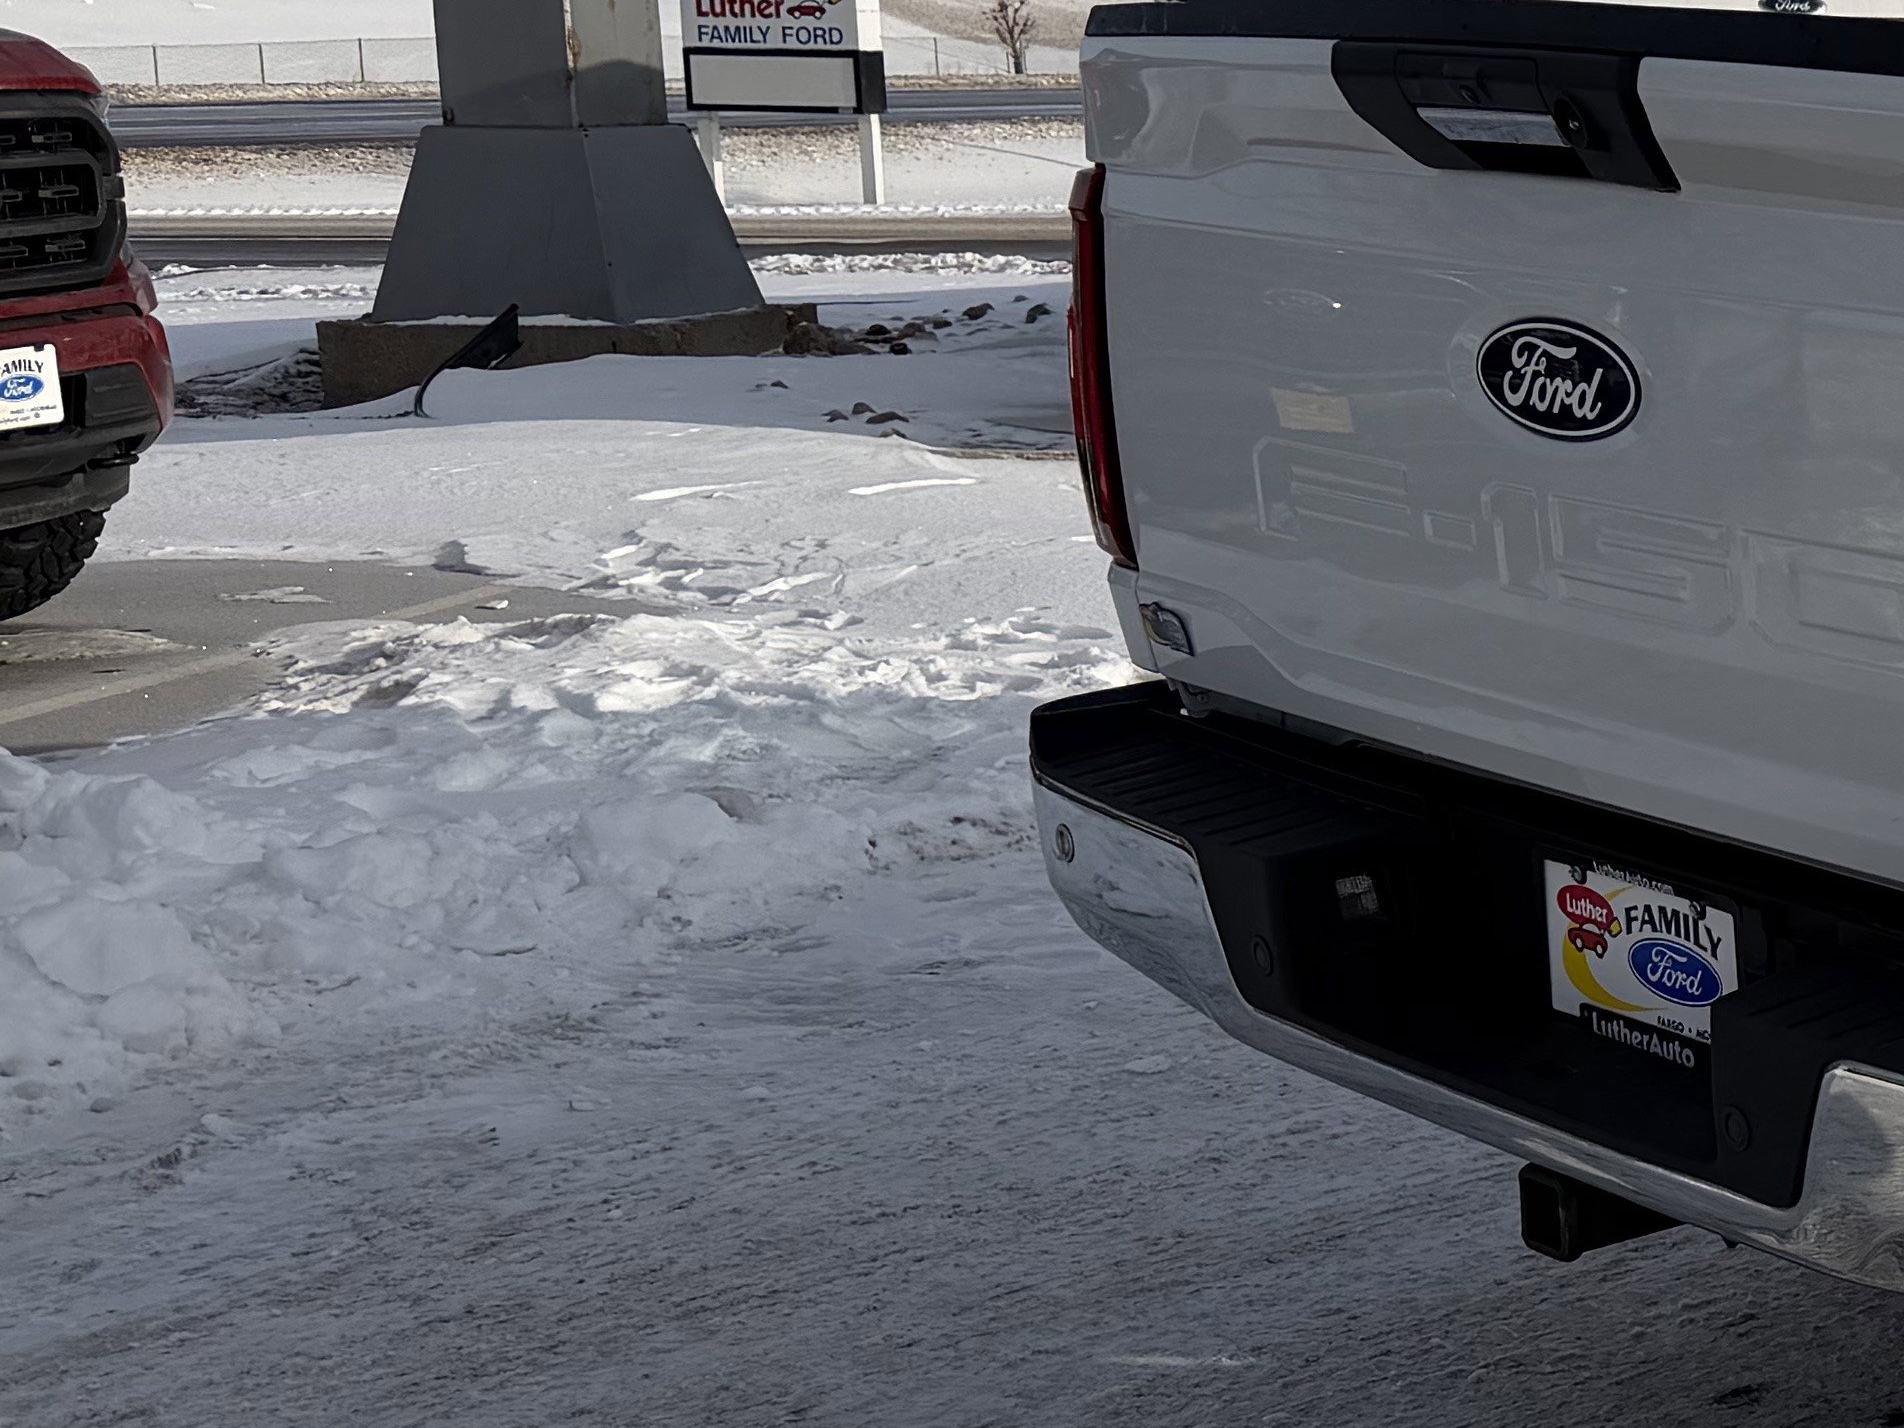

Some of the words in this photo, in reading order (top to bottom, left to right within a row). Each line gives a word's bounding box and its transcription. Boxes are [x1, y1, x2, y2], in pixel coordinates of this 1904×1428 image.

[697, 24, 771, 44] FAMILY
[781, 26, 844, 45] FORD
[0, 359, 44, 377] AMILY
[4, 378, 34, 397] Ford
[1503, 335, 1604, 421] Ford
[1565, 892, 1608, 924] Luther
[1624, 904, 1722, 961] FAMILY
[1647, 946, 1702, 995] Ford
[1592, 1011, 1695, 1068] LutherAuto
